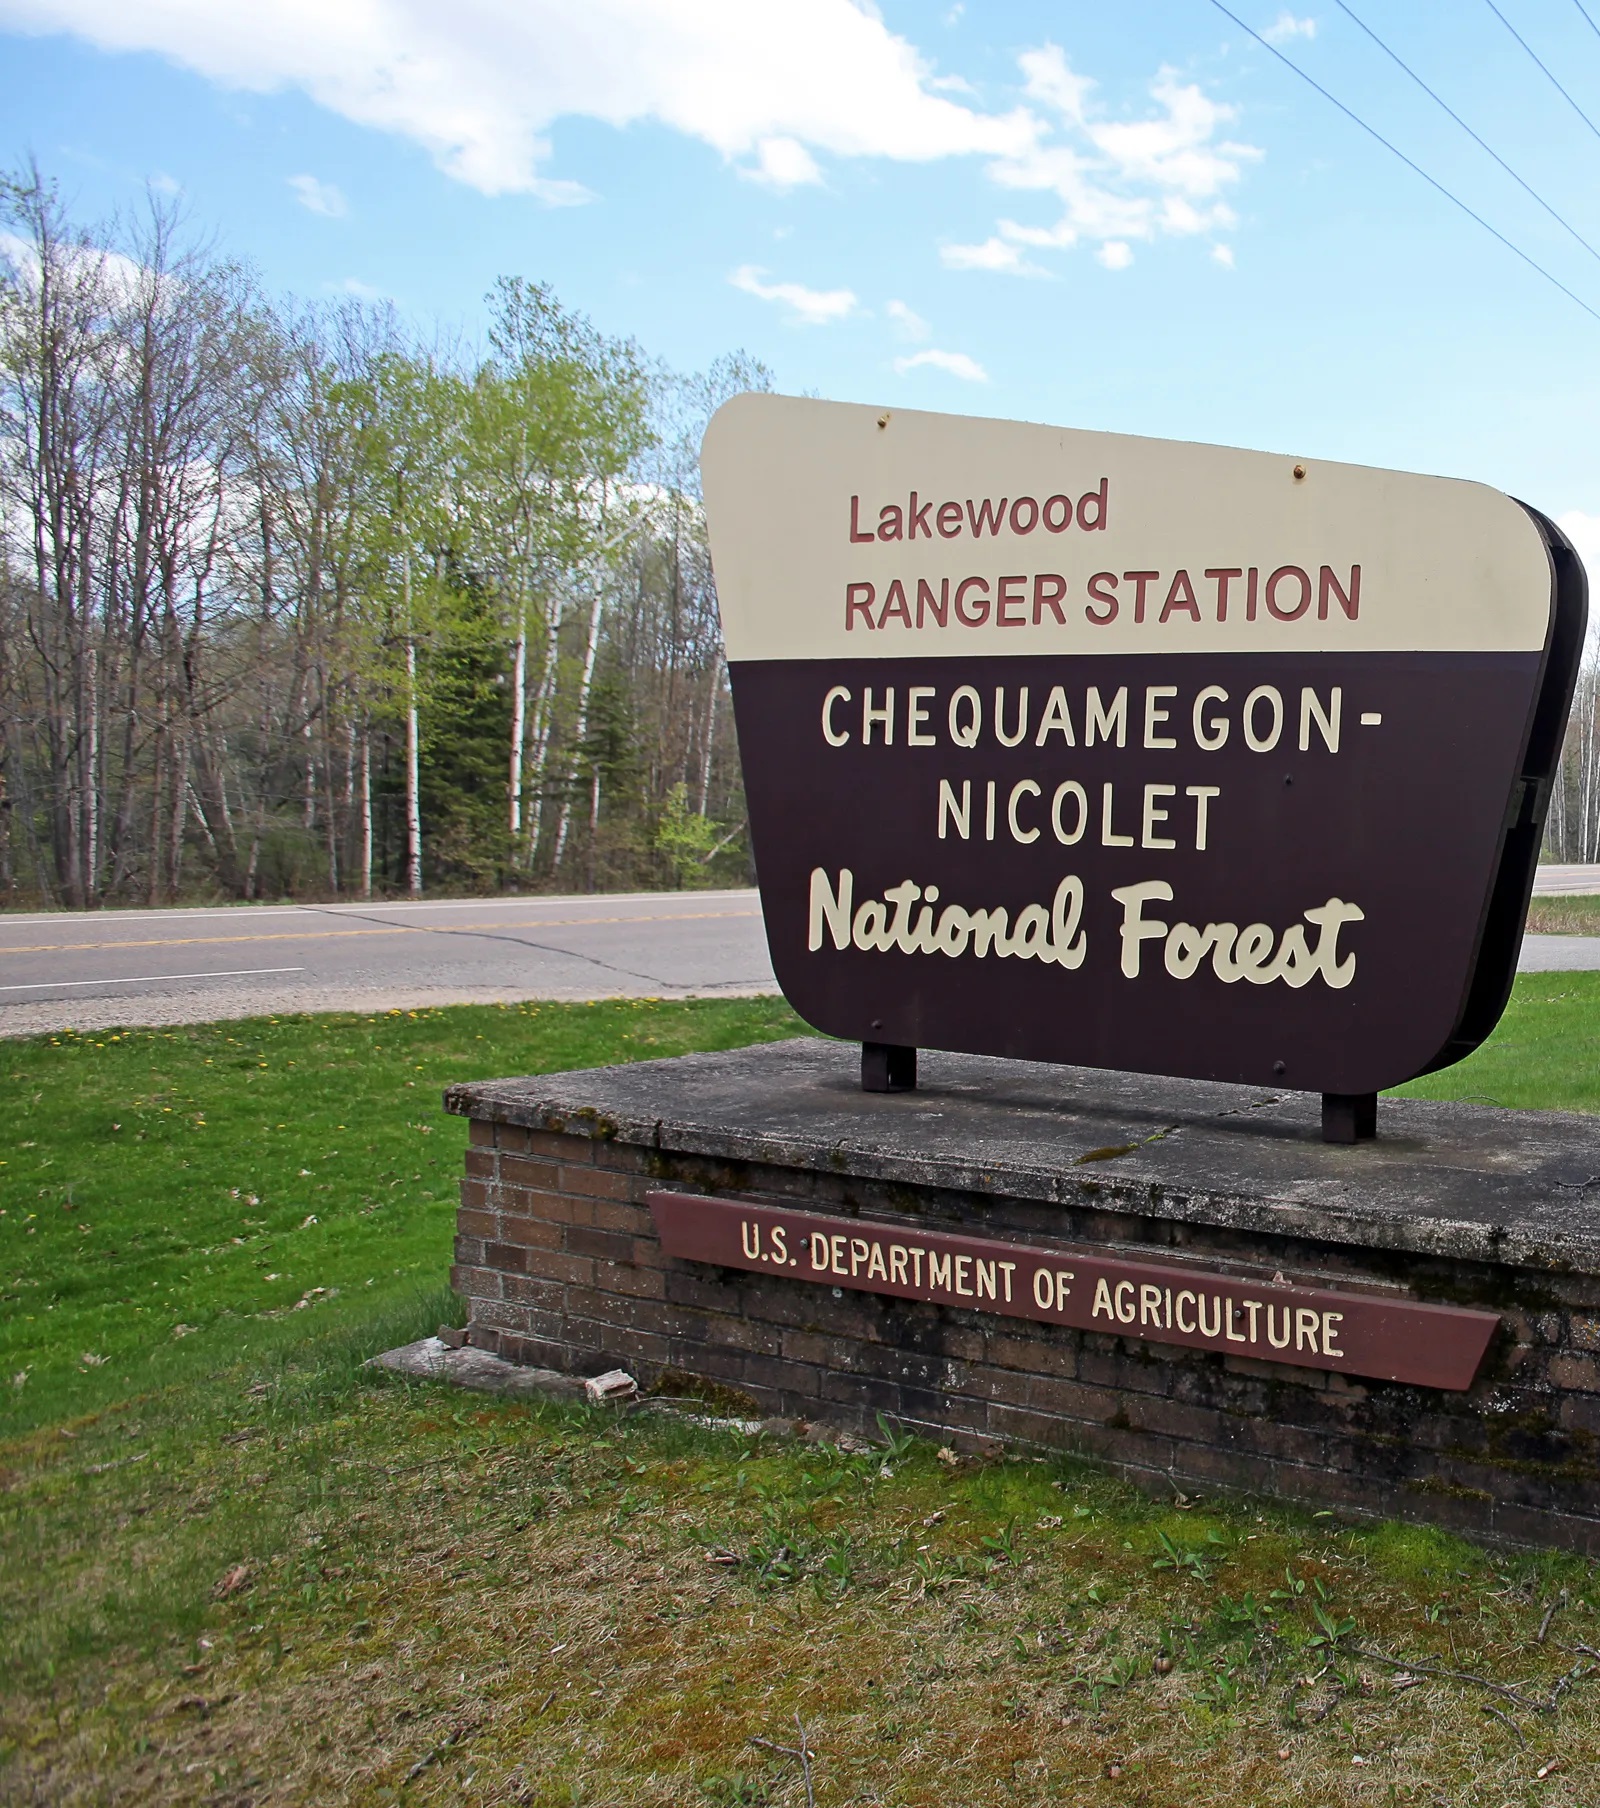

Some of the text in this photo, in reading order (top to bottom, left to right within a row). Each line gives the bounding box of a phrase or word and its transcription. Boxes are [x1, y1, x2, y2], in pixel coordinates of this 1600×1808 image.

[849, 477, 1109, 544] Lakewood
[844, 564, 1363, 631] RANGER STATION
[821, 684, 1383, 754] CHEQUAMEGON-
[937, 779, 1221, 851] NICOLET
[808, 867, 1365, 989] National Forest
[740, 1221, 1345, 1358] U.S. DEPARTMENT OF AGRICULTURE
